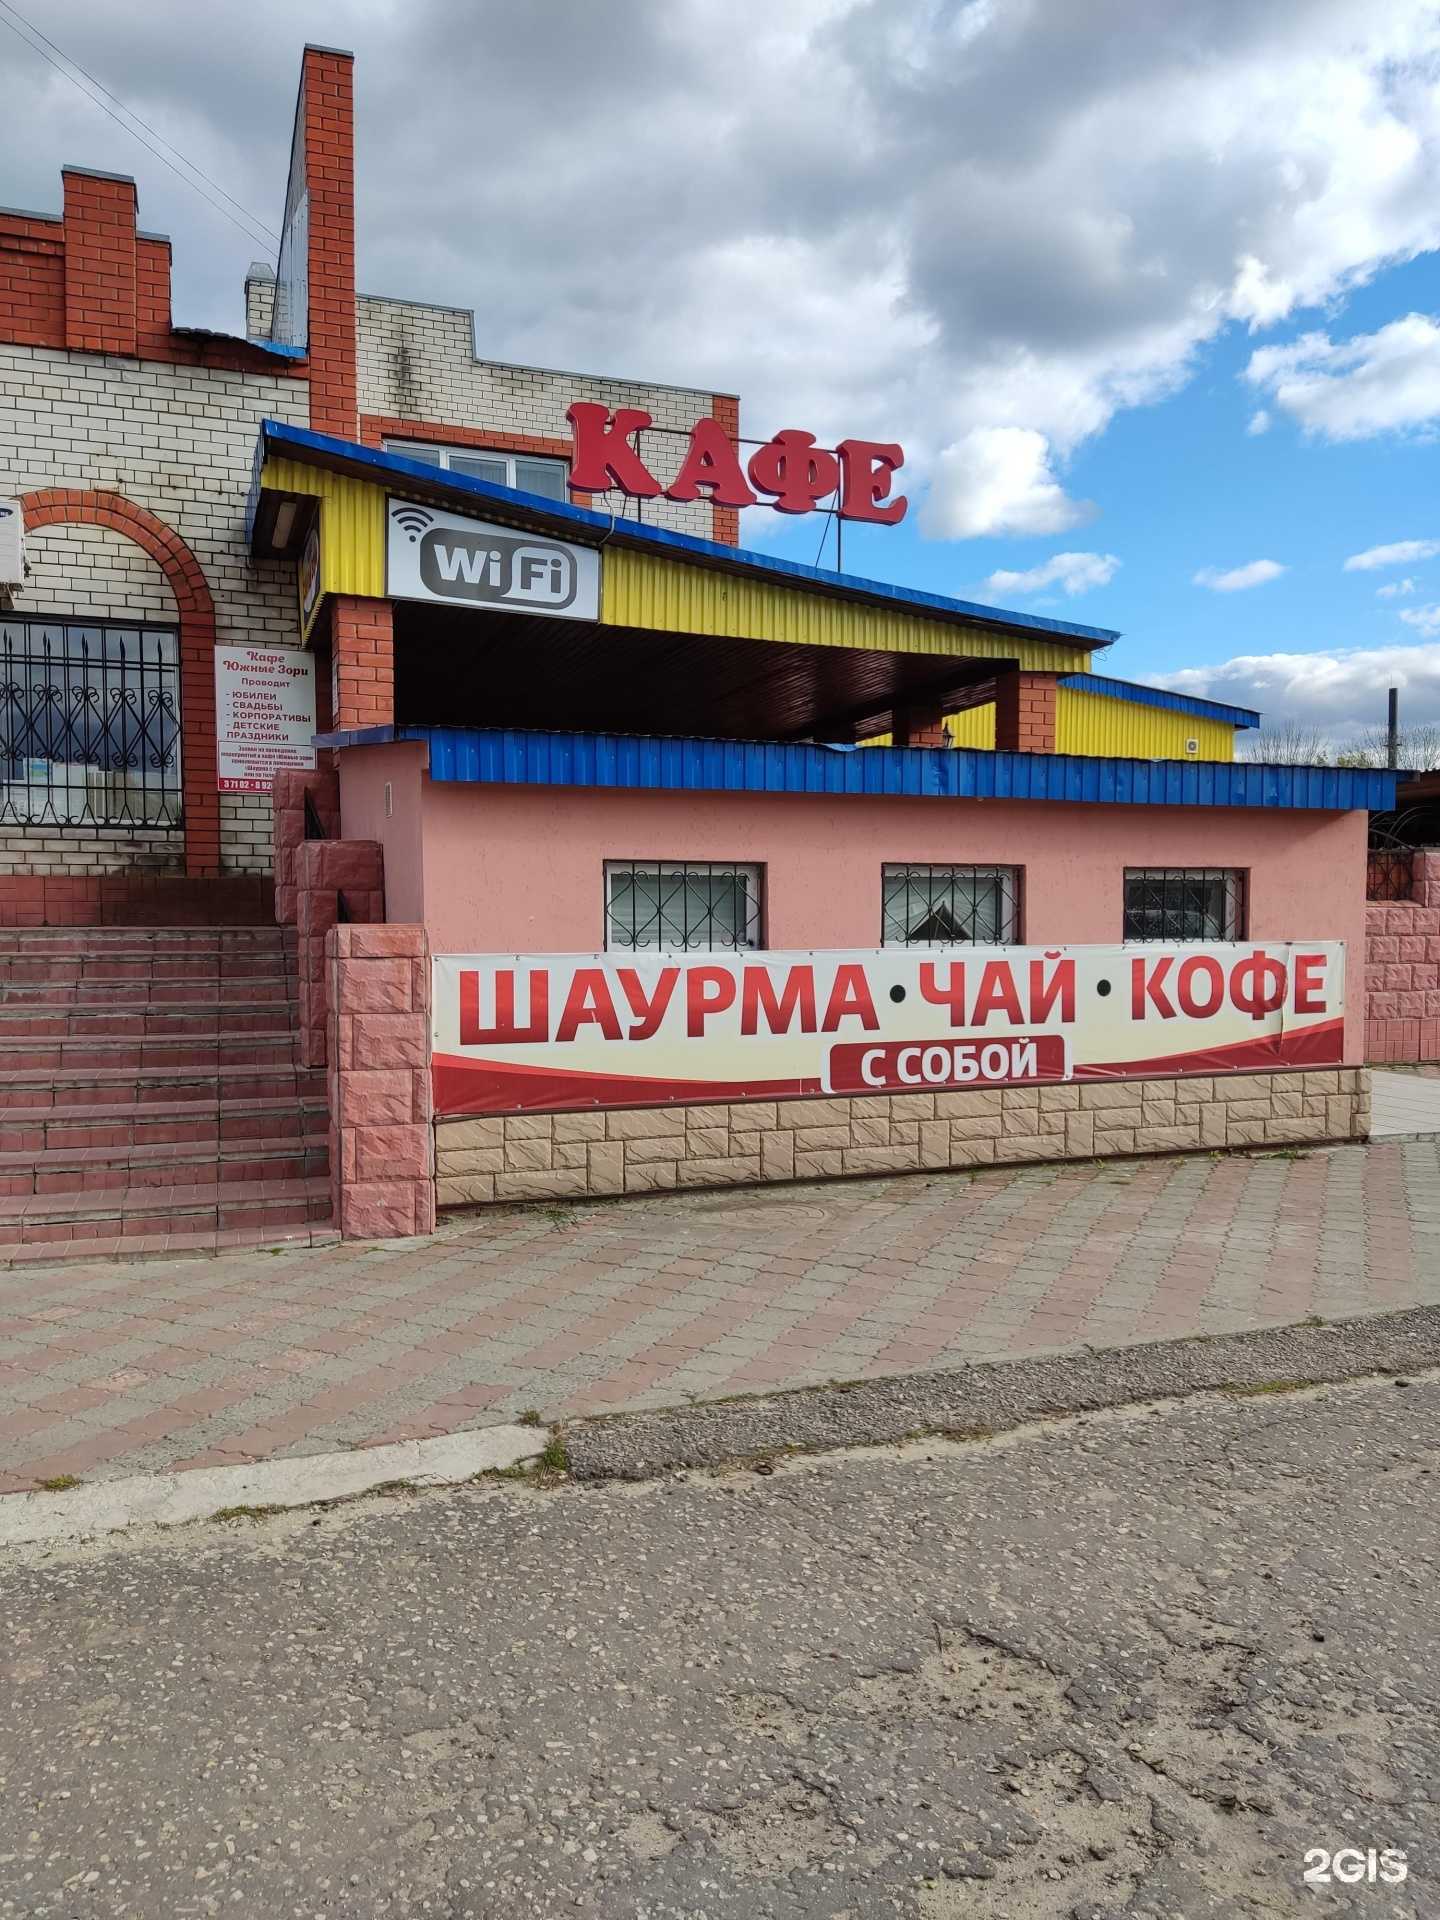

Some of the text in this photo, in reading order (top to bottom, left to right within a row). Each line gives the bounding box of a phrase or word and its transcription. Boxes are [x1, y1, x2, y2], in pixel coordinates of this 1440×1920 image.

[566, 402, 907, 526] КАФЕ
[246, 651, 285, 664] Кафе
[223, 660, 308, 677] Южные Зори
[241, 678, 290, 688] Проводит
[232, 701, 283, 711] СВАДЬБЫ
[232, 711, 311, 722] КОРПОРАТИВЫ
[233, 721, 280, 731] ДЕТСКИЕ
[226, 731, 289, 741] ПРАЗДНИКИ
[459, 950, 1327, 1046] ШАУРМА ЧАЙ КОФЕ
[897, 1037, 1037, 1084] СОБОЙ
